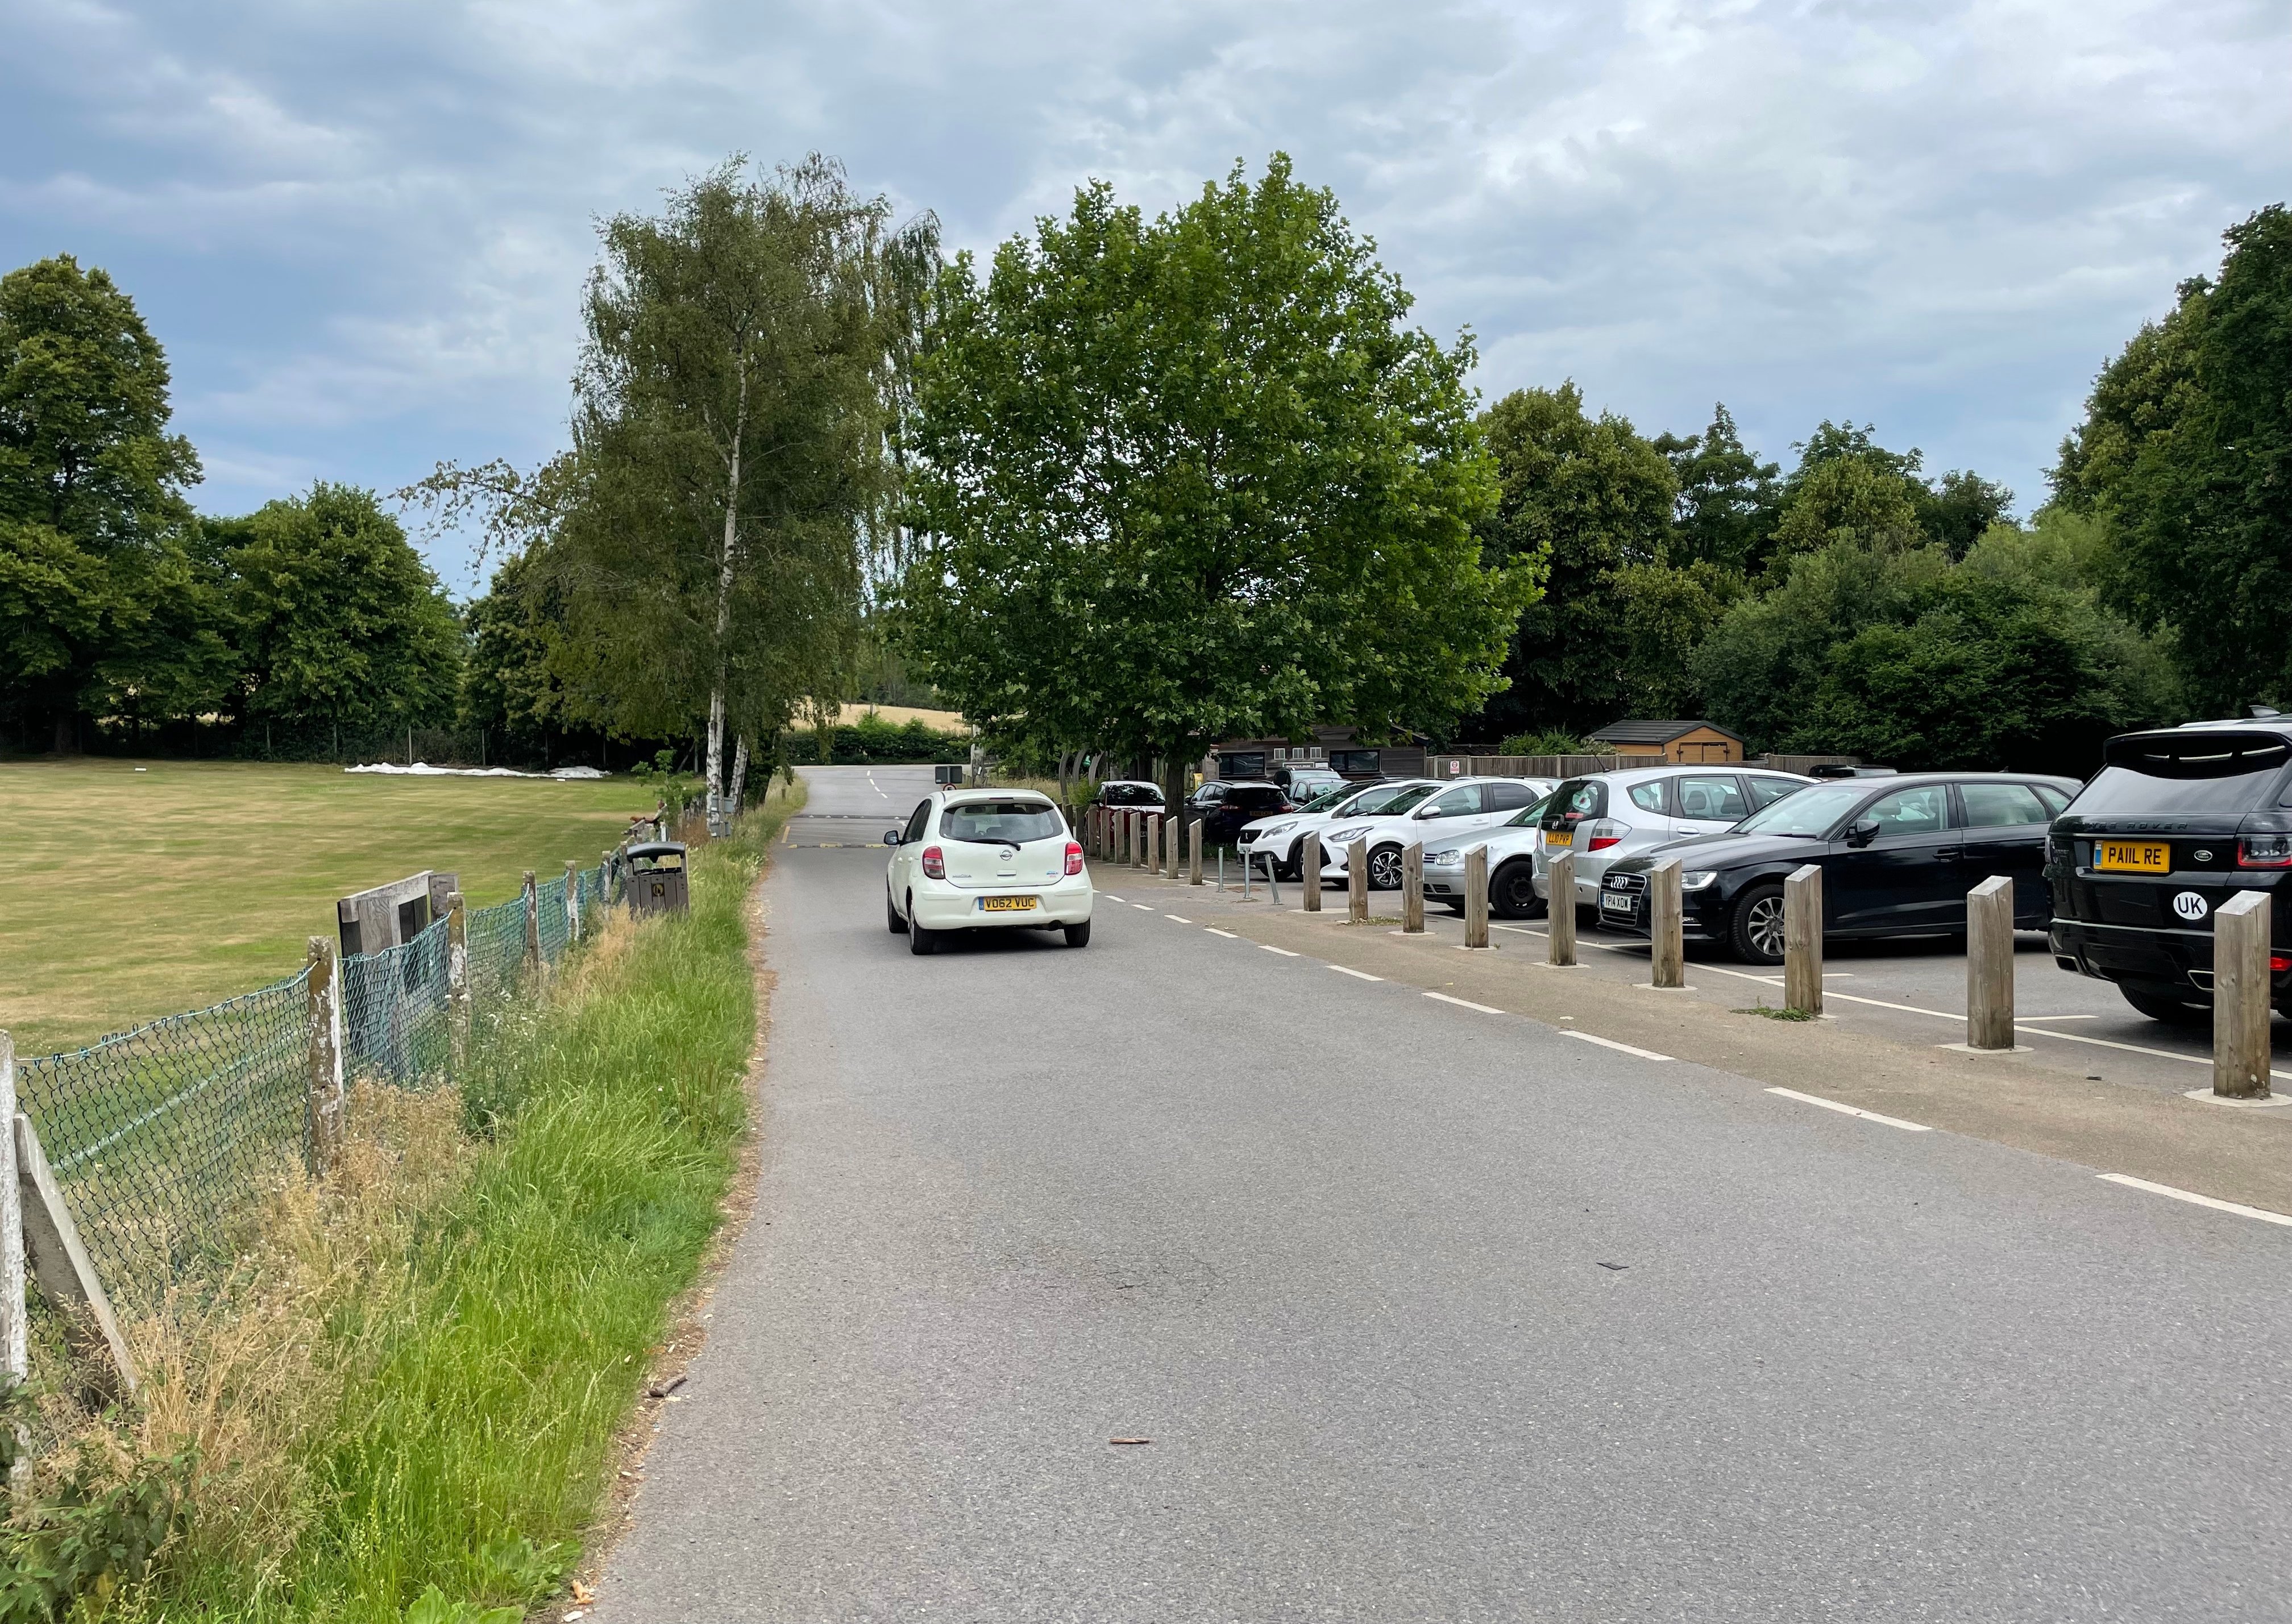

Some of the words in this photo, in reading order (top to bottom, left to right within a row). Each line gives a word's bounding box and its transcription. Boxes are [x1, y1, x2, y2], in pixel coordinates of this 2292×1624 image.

[2144, 848, 2162, 865] RE
[1015, 898, 1035, 908] VUC
[2177, 896, 2203, 915] UK
